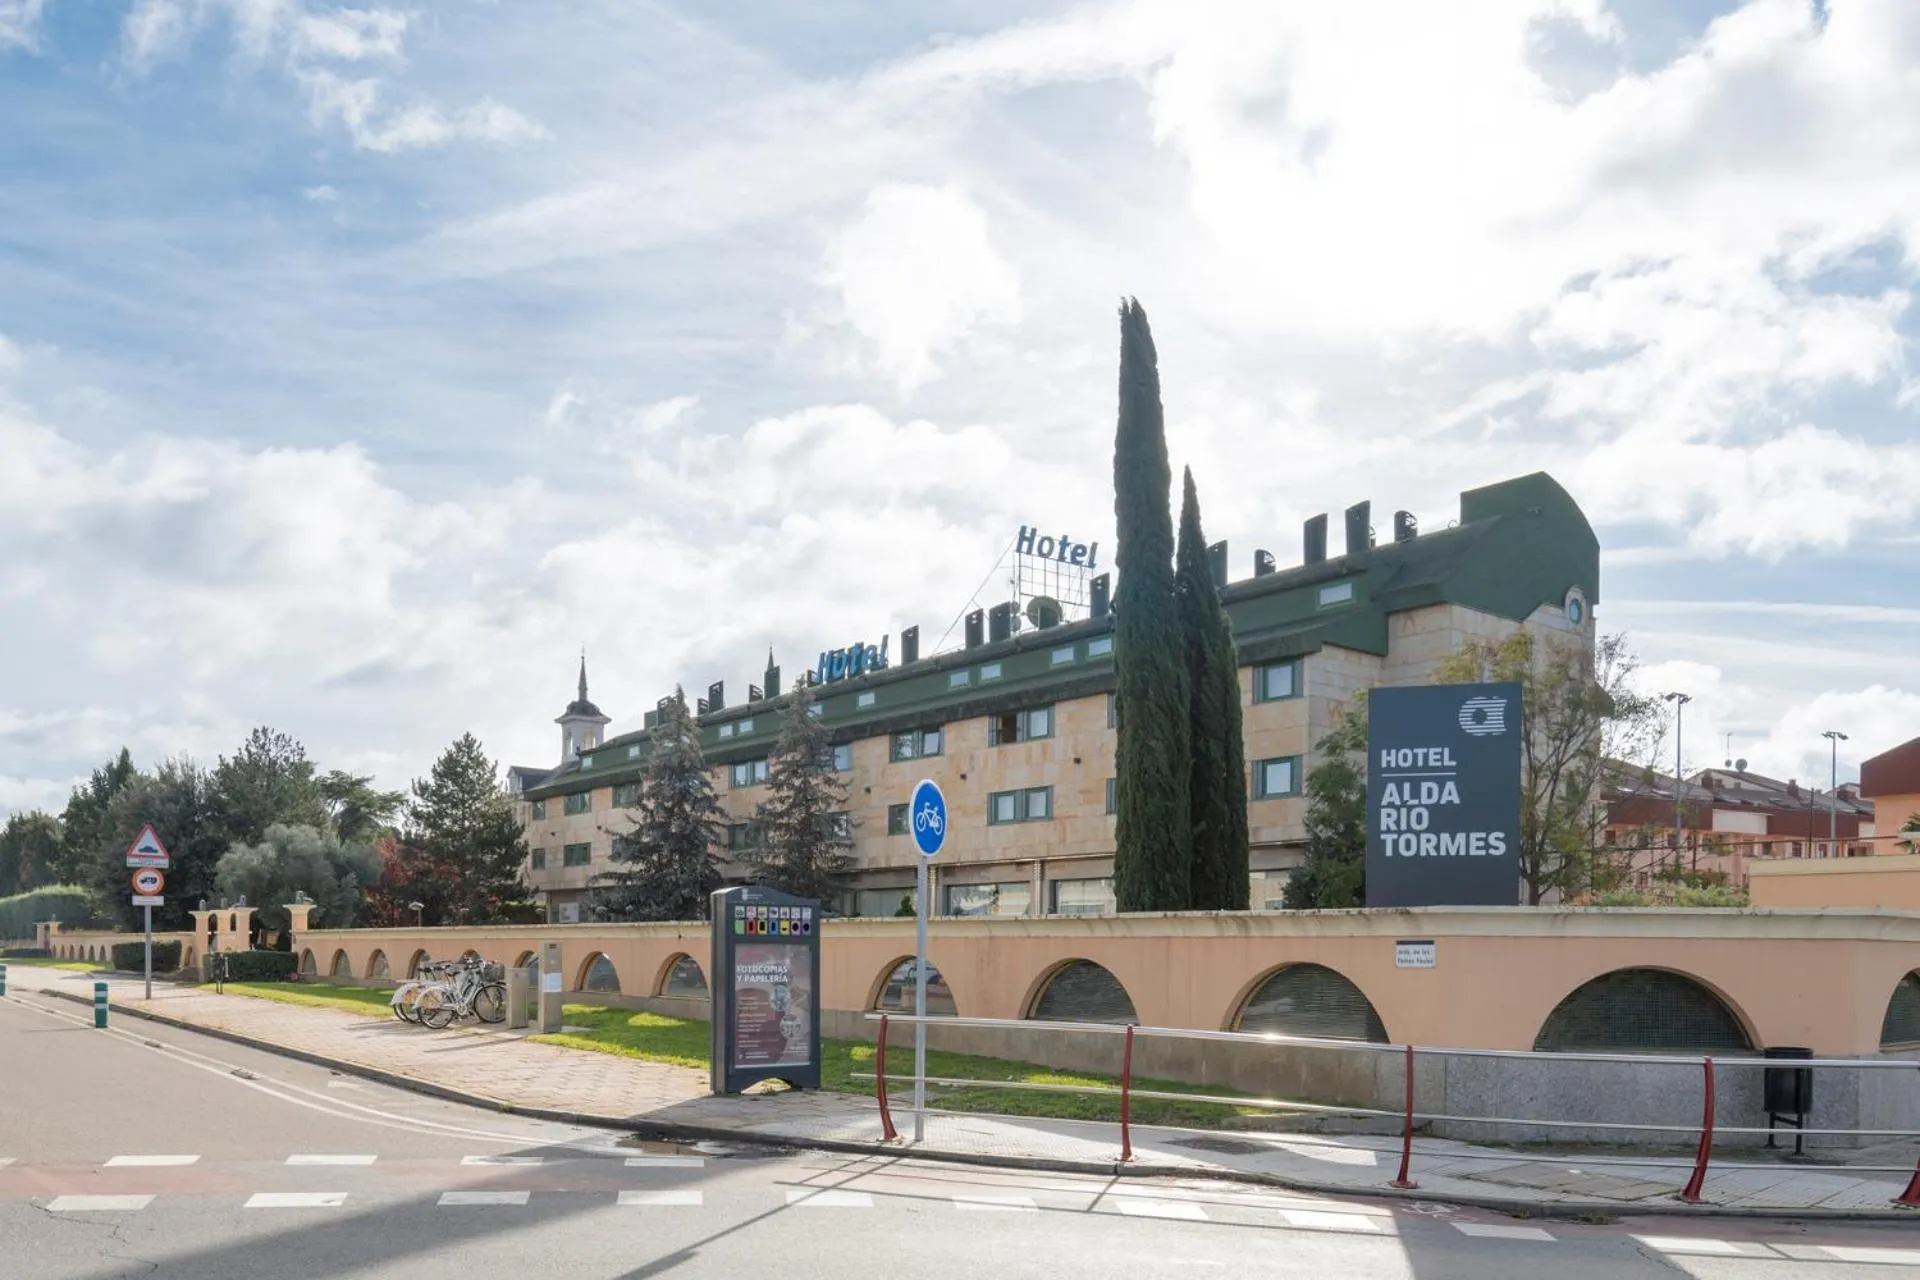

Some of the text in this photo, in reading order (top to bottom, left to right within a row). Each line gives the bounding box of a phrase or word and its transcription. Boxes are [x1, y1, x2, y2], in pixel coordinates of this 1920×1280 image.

[1016, 525, 1098, 569] Hotel
[1381, 747, 1457, 768] HOTEL
[1380, 781, 1460, 806] ALDA
[1380, 832, 1506, 857] TORMES
